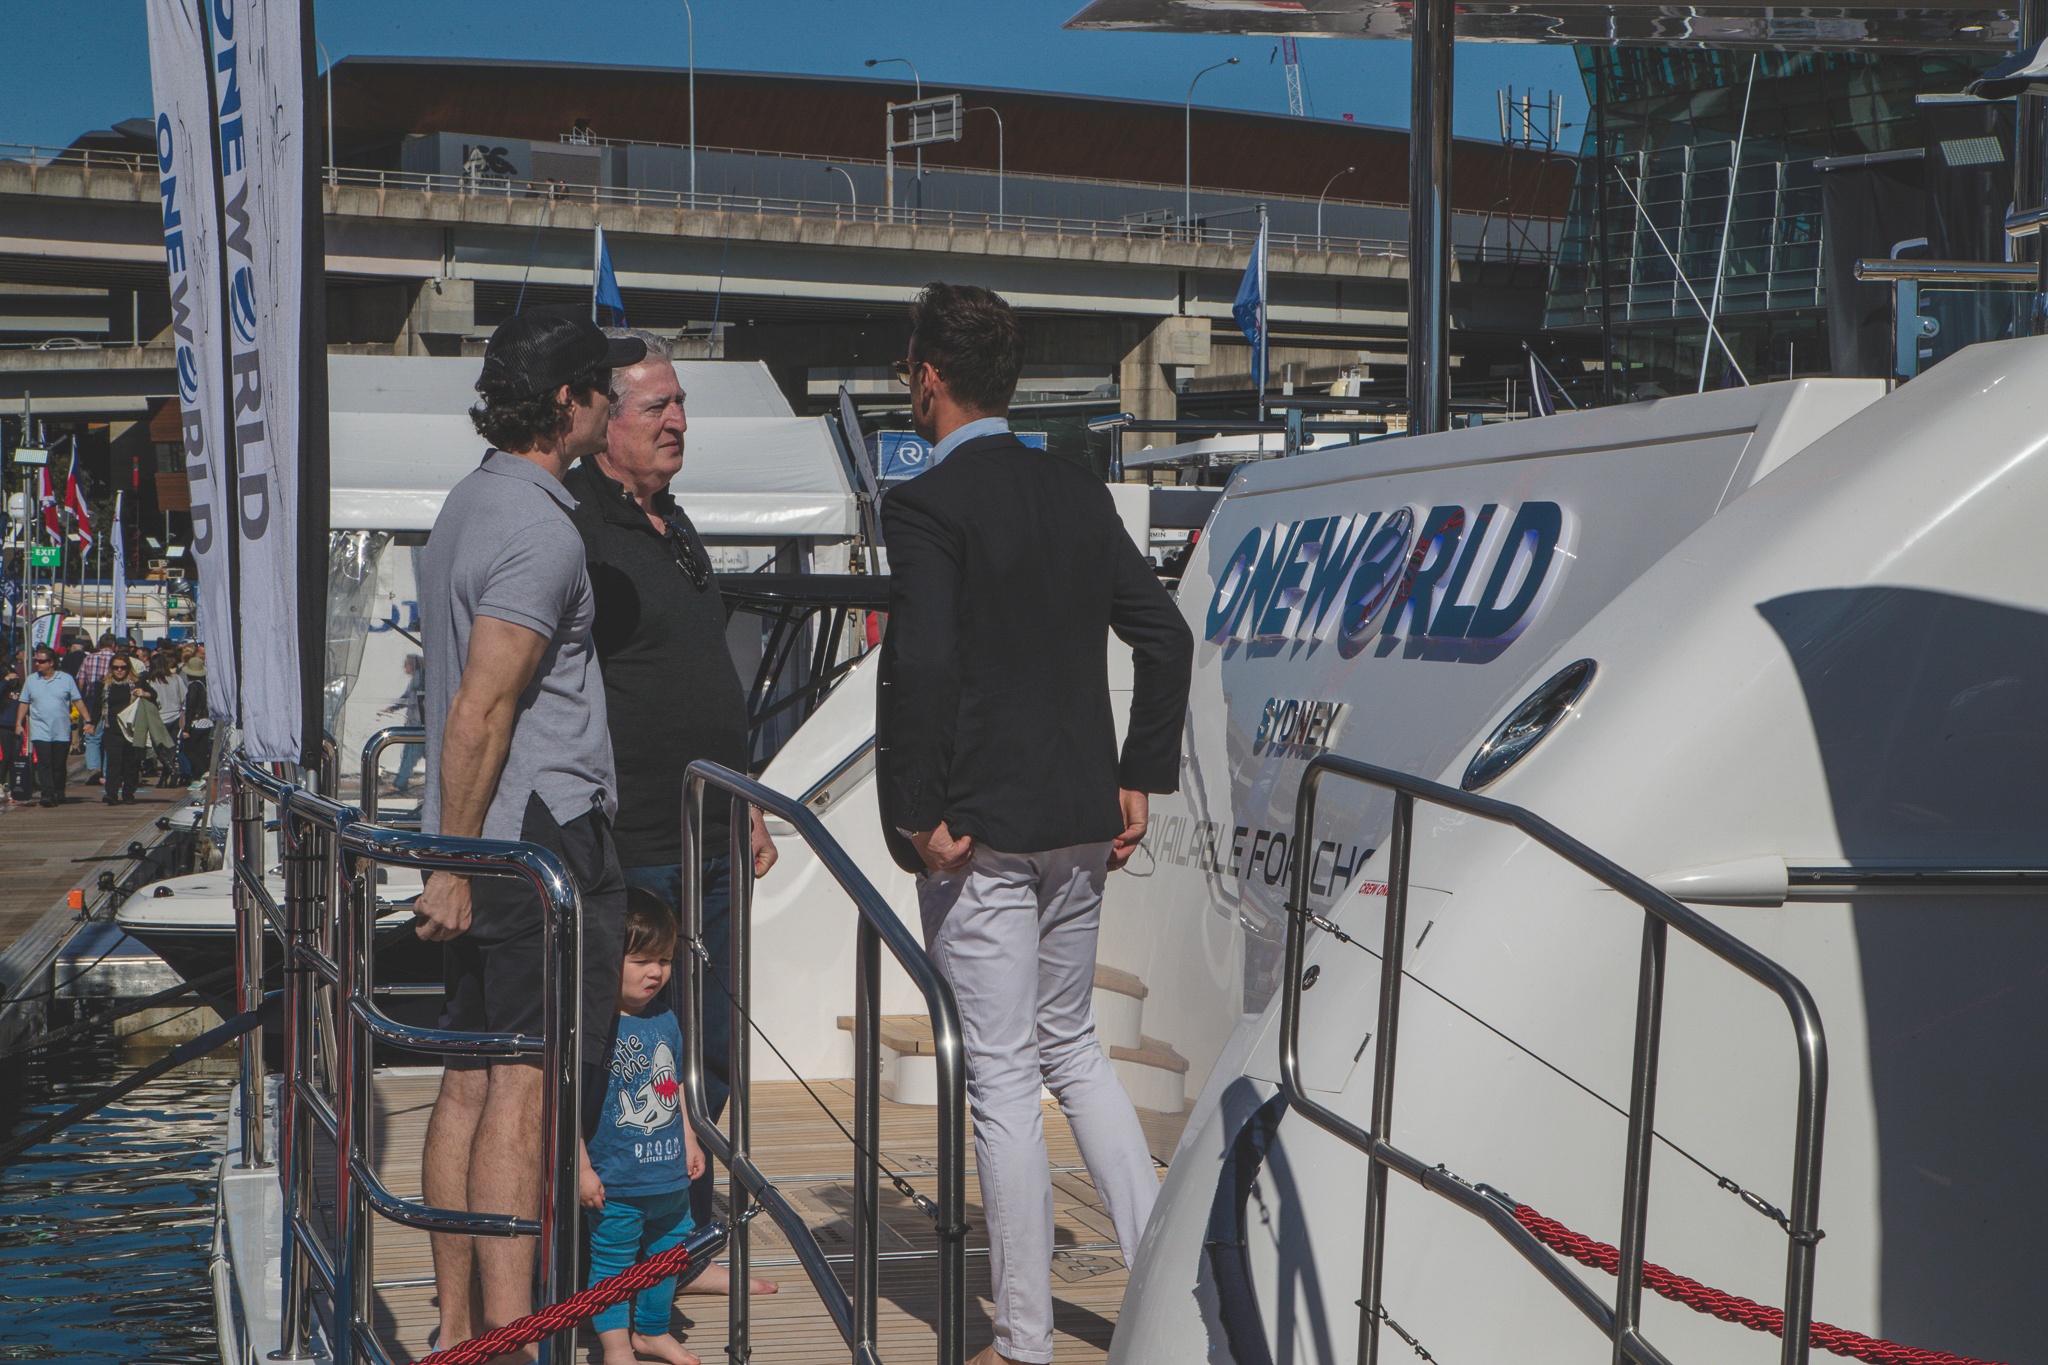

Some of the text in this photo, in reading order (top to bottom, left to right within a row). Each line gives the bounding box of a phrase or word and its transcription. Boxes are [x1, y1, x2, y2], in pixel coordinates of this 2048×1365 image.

[1204, 500, 1568, 646] ONEWORLD
[1255, 697, 1346, 748] SYDNEY
[1358, 882, 1380, 895] CREW
[604, 1035, 643, 1077] Bite
[622, 1054, 650, 1083] Me
